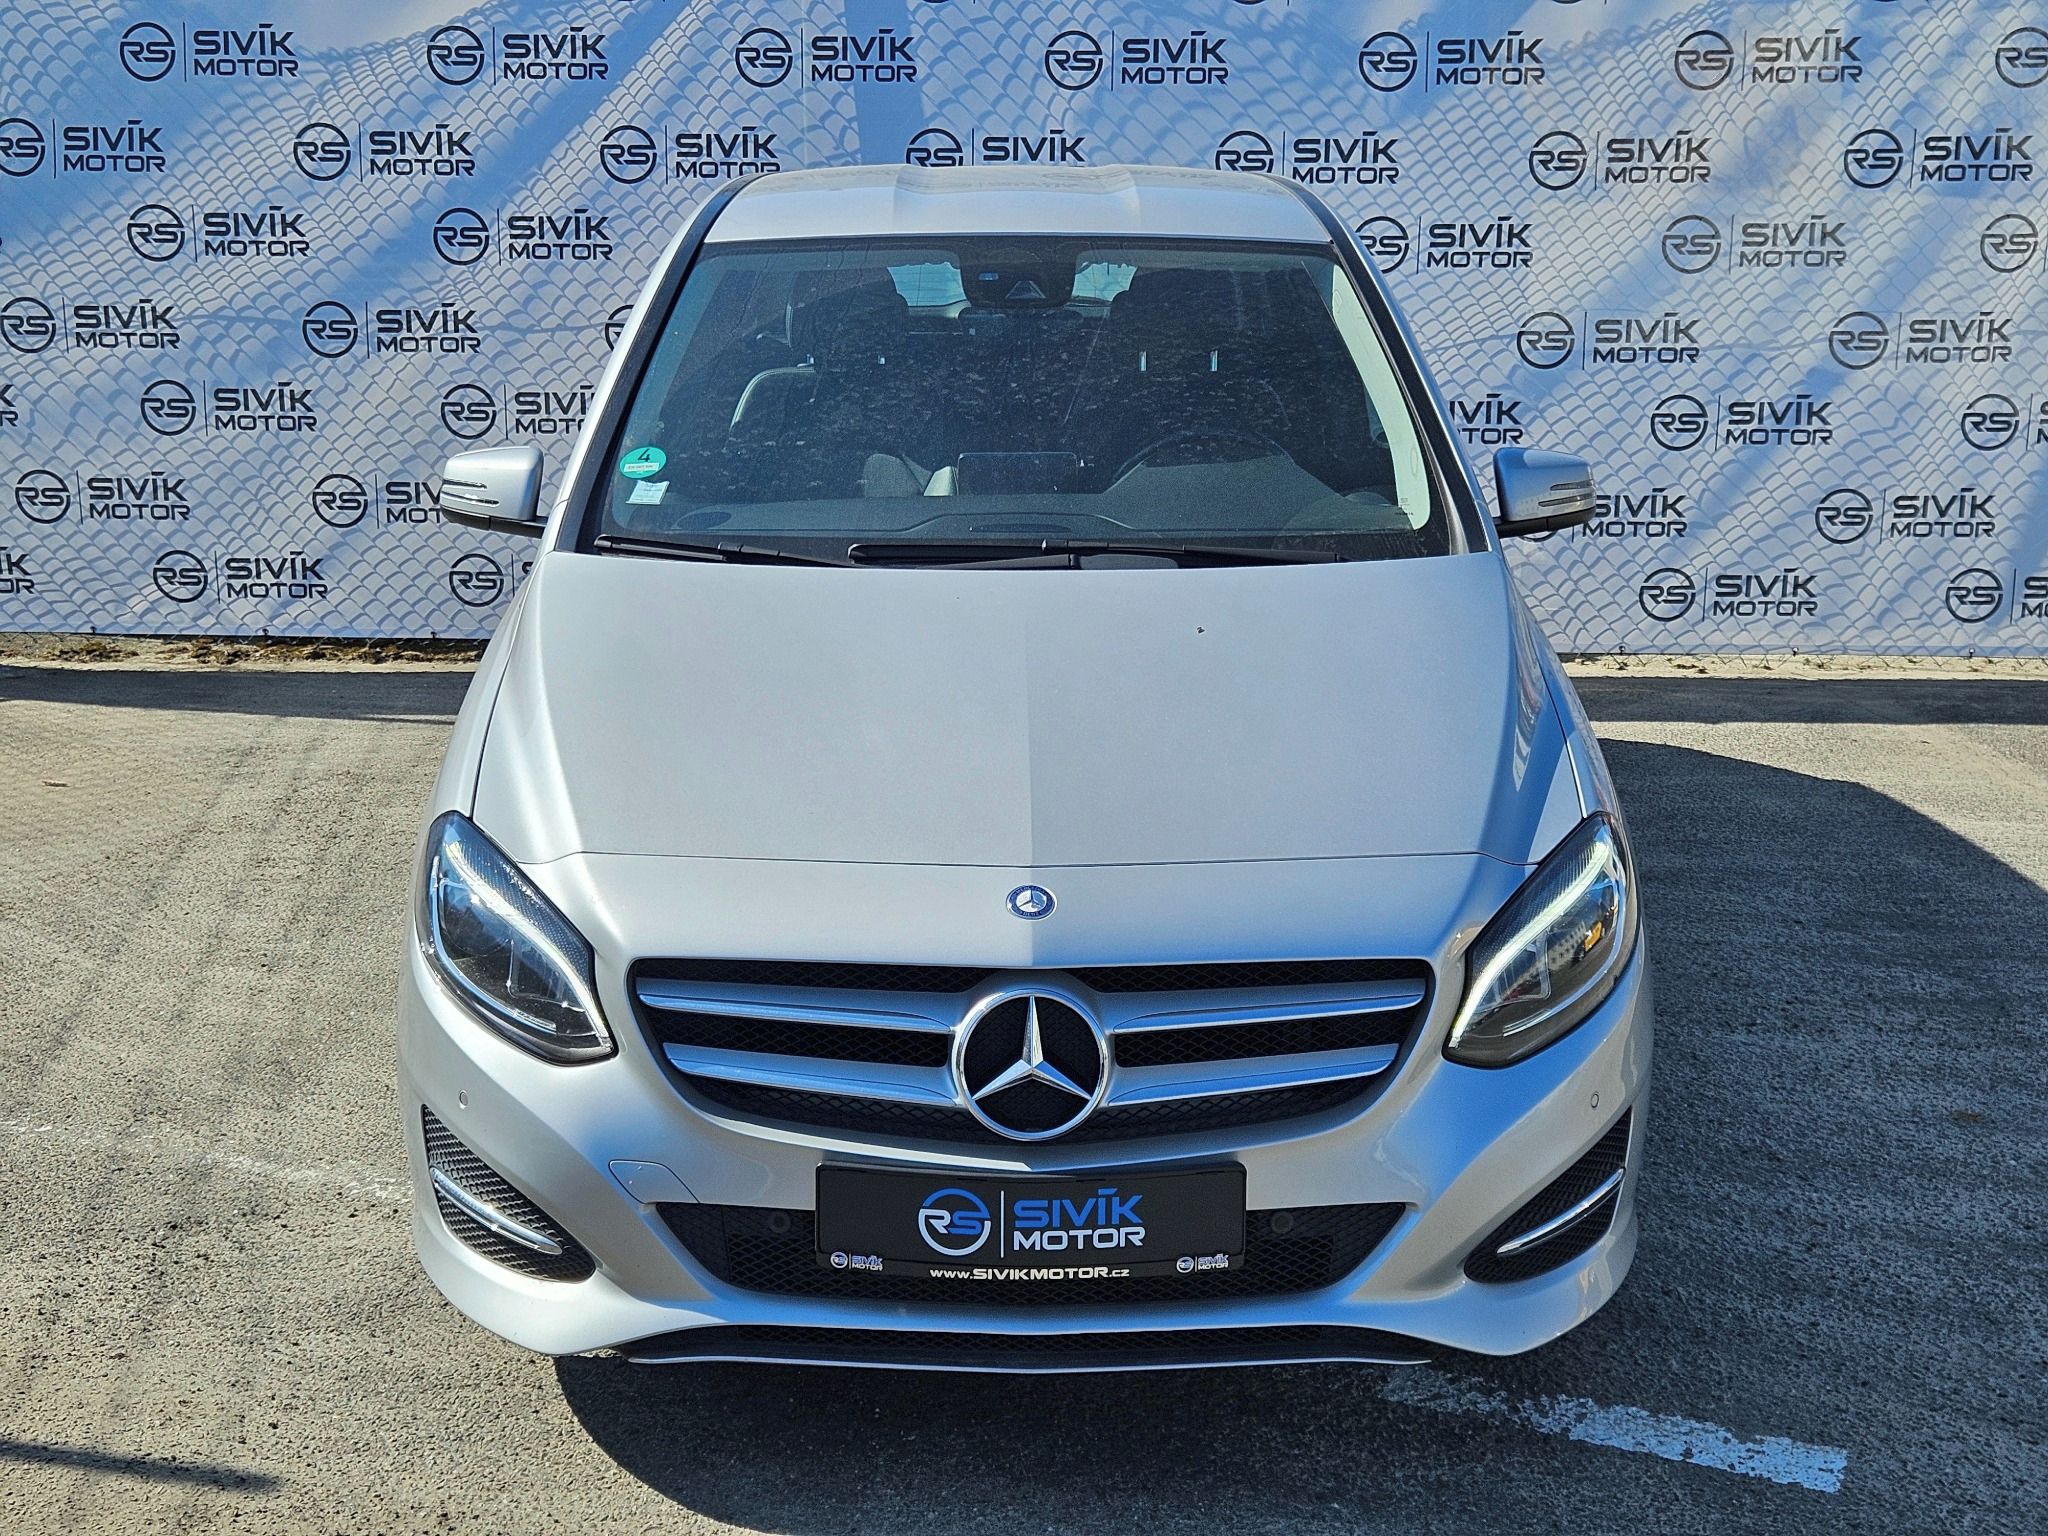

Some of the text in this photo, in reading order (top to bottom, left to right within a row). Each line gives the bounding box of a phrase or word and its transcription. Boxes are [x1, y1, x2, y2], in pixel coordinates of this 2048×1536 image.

[194, 59, 298, 76] MOTOR
[504, 63, 608, 80] MOTOR
[812, 65, 917, 82] MOTOR
[1122, 67, 1228, 84] MOTOR
[1752, 66, 1862, 83] MOTOR
[1437, 68, 1545, 85] MOTOR
[64, 155, 165, 172] MOTOR
[370, 159, 475, 176] MOTOR
[1293, 167, 1399, 184] MOTOR
[1605, 166, 1710, 183] MOTOR
[1921, 164, 2032, 181] MOTOR
[205, 240, 309, 256] MOTOR
[509, 243, 613, 260] MOTOR
[1427, 252, 1533, 268] MOTOR
[1739, 251, 1846, 267] MOTOR
[75, 332, 180, 349] MOTOR
[377, 337, 480, 353] MOTOR
[1593, 347, 1699, 363] MOTOR
[1906, 346, 2012, 363] MOTOR
[215, 415, 317, 431] MOTOR
[516, 418, 584, 434] MOT
[1459, 428, 1523, 444] TOR
[1726, 429, 1832, 445] MOTOR
[638, 448, 650, 462] 4
[90, 503, 190, 520] MOTOR
[387, 507, 443, 523] MOT
[1891, 522, 1995, 537] MOTOR
[227, 583, 327, 599] MOTOR
[1713, 601, 1817, 616] MOTOR
[1013, 1226, 1146, 1250] MOTOR
